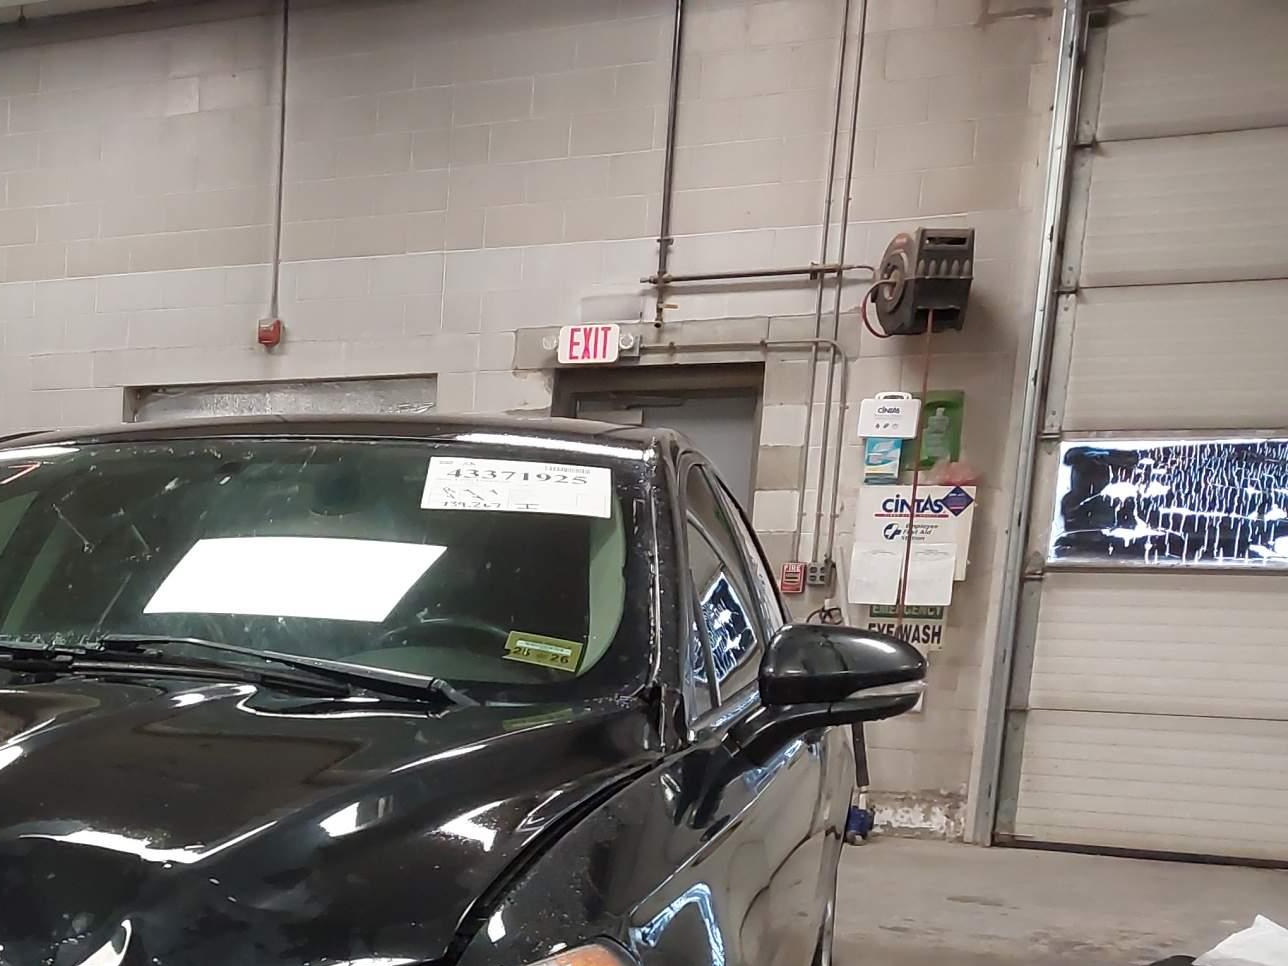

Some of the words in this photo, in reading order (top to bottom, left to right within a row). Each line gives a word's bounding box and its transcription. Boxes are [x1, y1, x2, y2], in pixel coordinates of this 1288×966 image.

[569, 327, 612, 360] EXIT
[447, 468, 589, 485] 43371925
[882, 494, 944, 513] CINTAS
[894, 624, 942, 644] WASH
